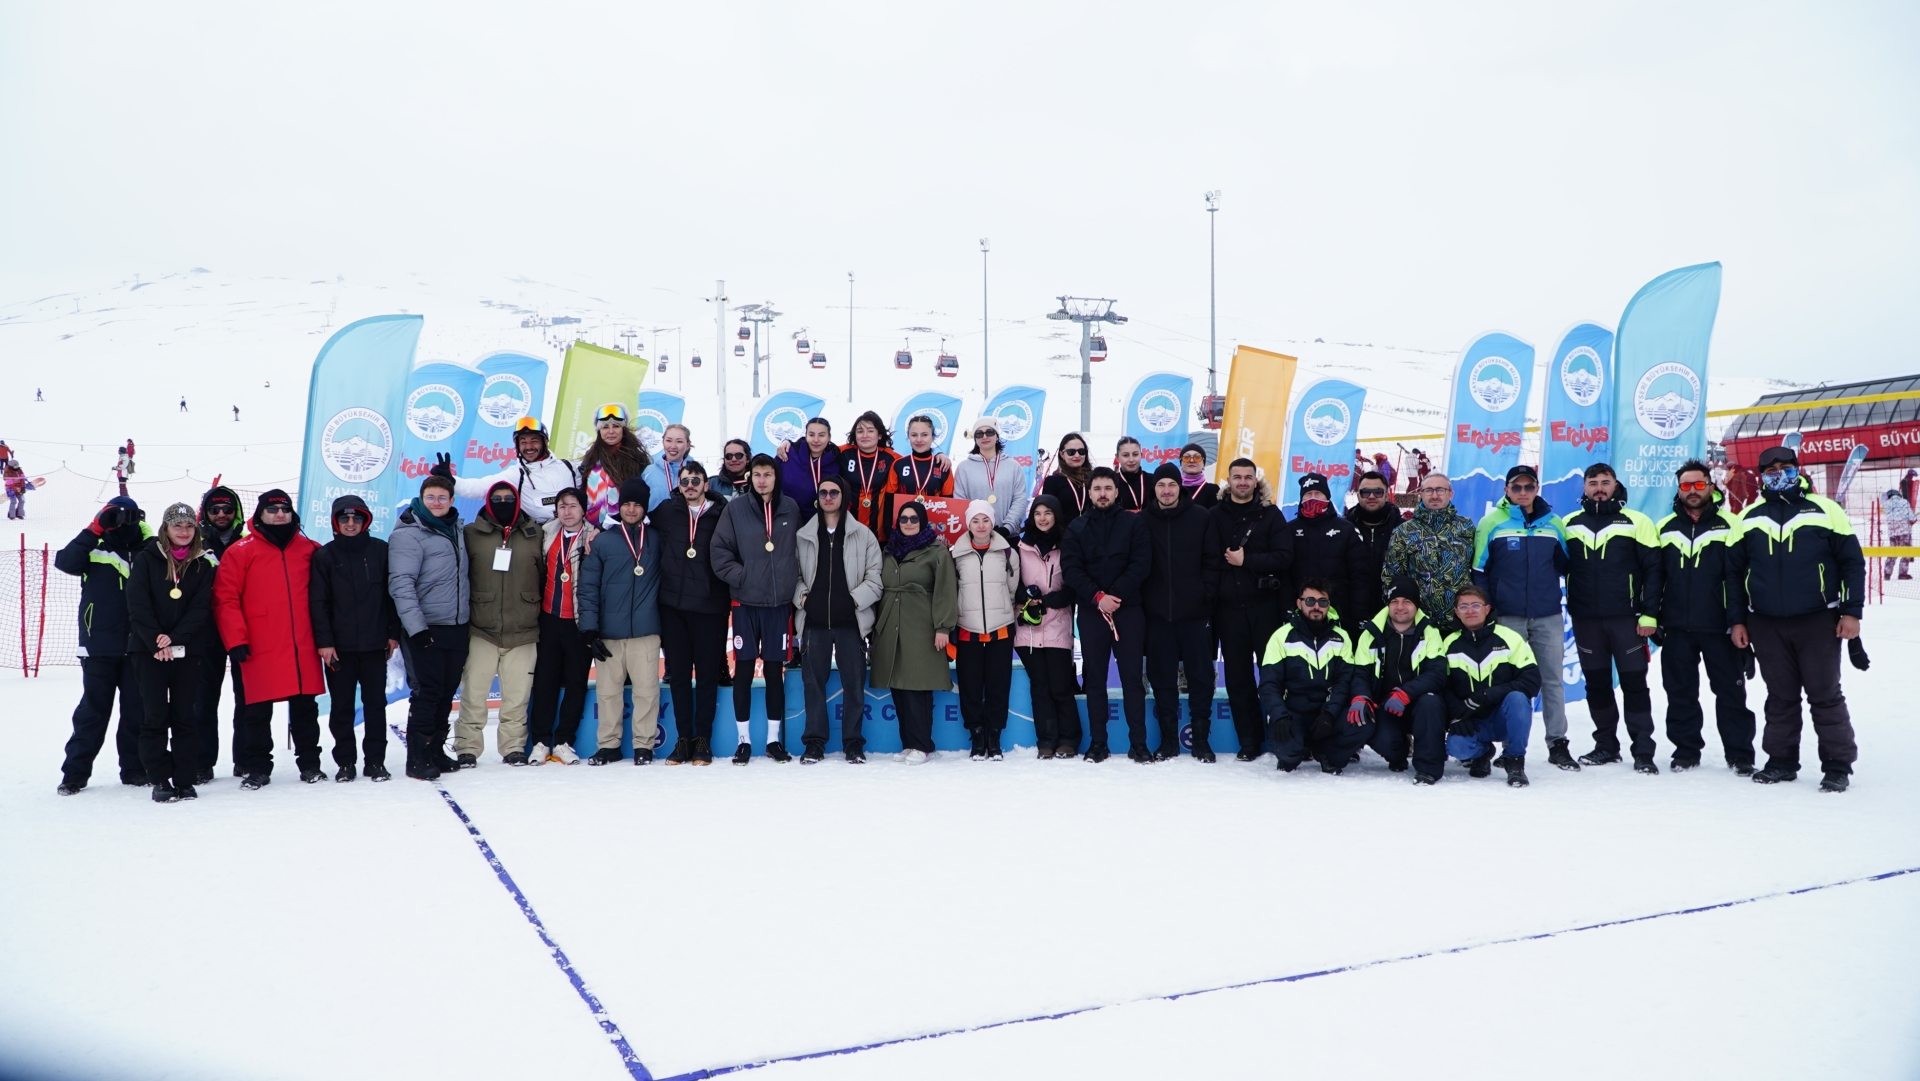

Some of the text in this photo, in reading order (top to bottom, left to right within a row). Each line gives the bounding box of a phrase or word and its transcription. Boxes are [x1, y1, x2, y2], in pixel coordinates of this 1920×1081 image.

[1638, 382, 1647, 416] KAYSERİ
[1646, 365, 1690, 382] BÜYÜKŞEHİR
[324, 410, 391, 466] KAYSERİ BÜYÜKŞEHİR BELEDİYESİ
[566, 431, 576, 459] YÜKŞEHİR
[1239, 427, 1255, 460] OR
[1457, 424, 1521, 454] Erciyes
[1550, 421, 1609, 452] Erciyes
[1639, 444, 1689, 457] KAYSERİ
[1801, 435, 1857, 453] KAYSERİ
[465, 440, 517, 469] Erciye
[848, 460, 855, 472] 8
[1141, 445, 1182, 465] rciyes
[902, 466, 910, 476] 6
[1629, 474, 1679, 487] BELEDİY
